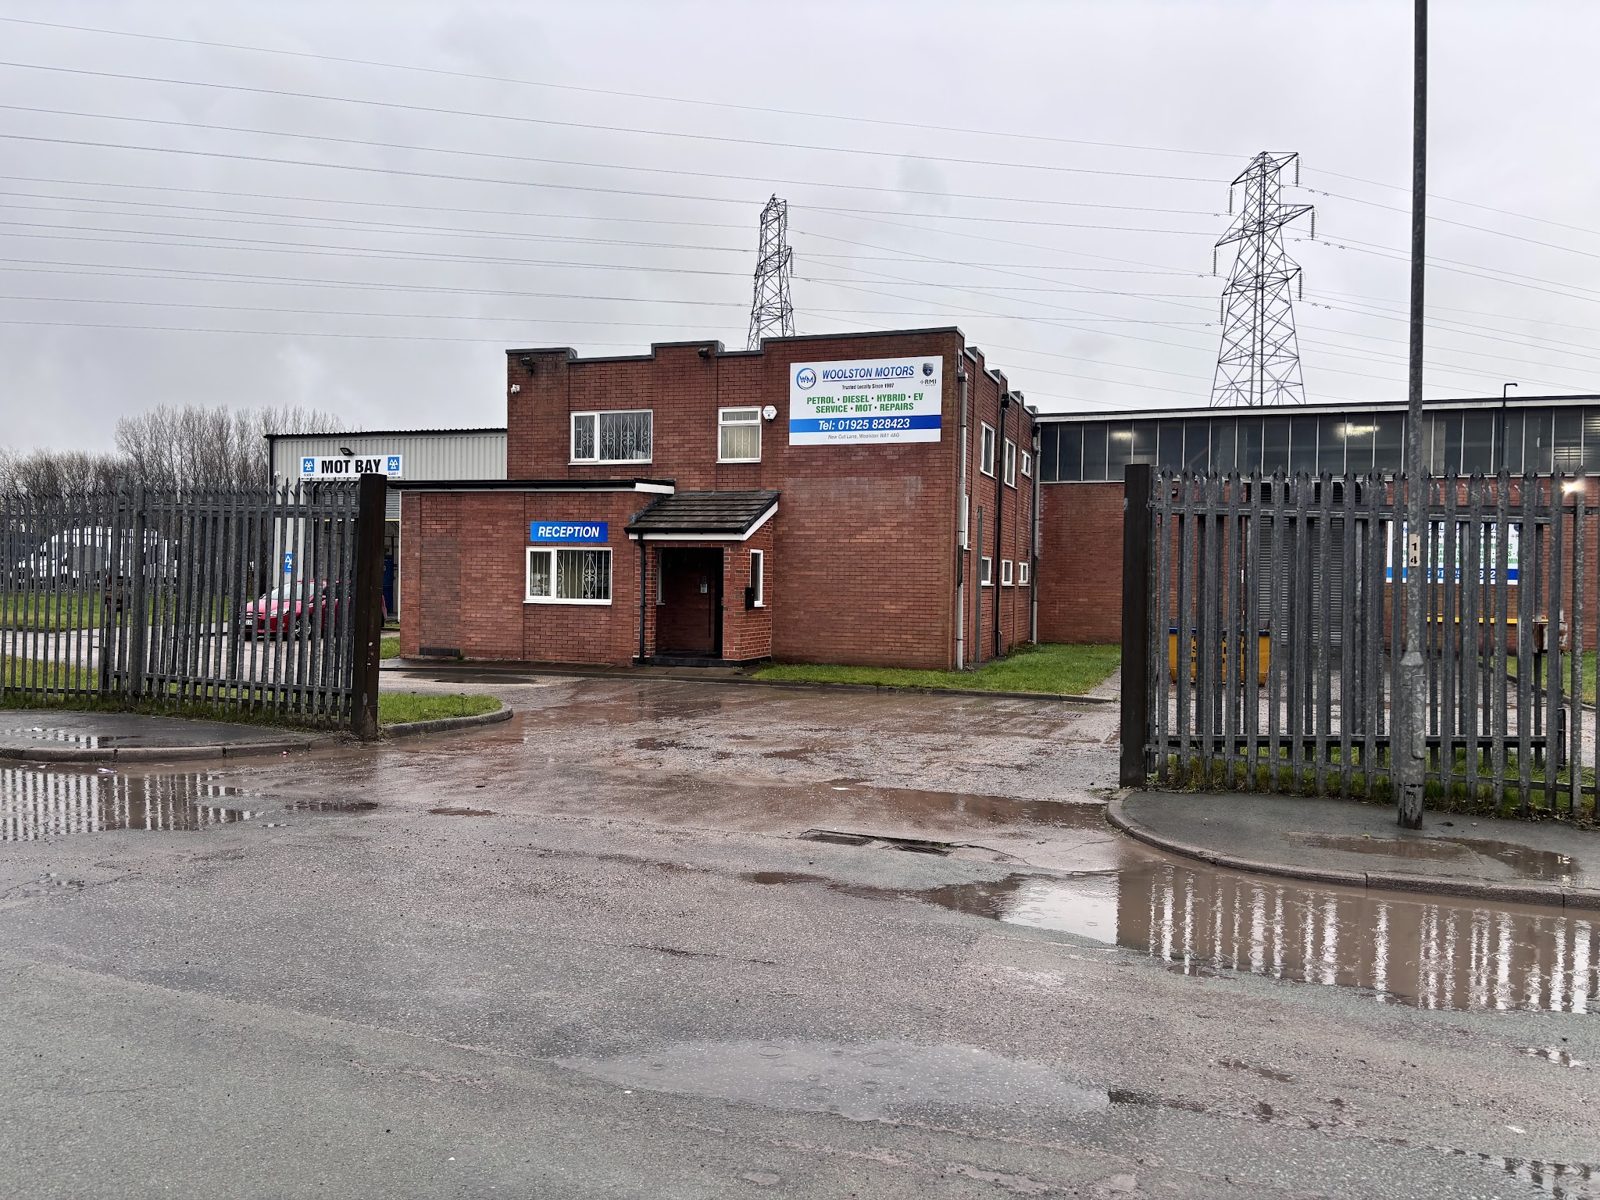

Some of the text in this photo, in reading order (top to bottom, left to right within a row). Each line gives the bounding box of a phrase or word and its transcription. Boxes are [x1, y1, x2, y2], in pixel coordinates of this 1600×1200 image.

[822, 366, 914, 380] WOOLSTON MOTORS
[806, 393, 924, 405] PETROL DIESEL HYBRID EV
[815, 402, 914, 414] SERVICE MOT REPAIRS
[818, 418, 910, 431] Tel: 01925 828423
[321, 459, 382, 474] MOT BAY
[538, 526, 600, 538] RECEPTION
